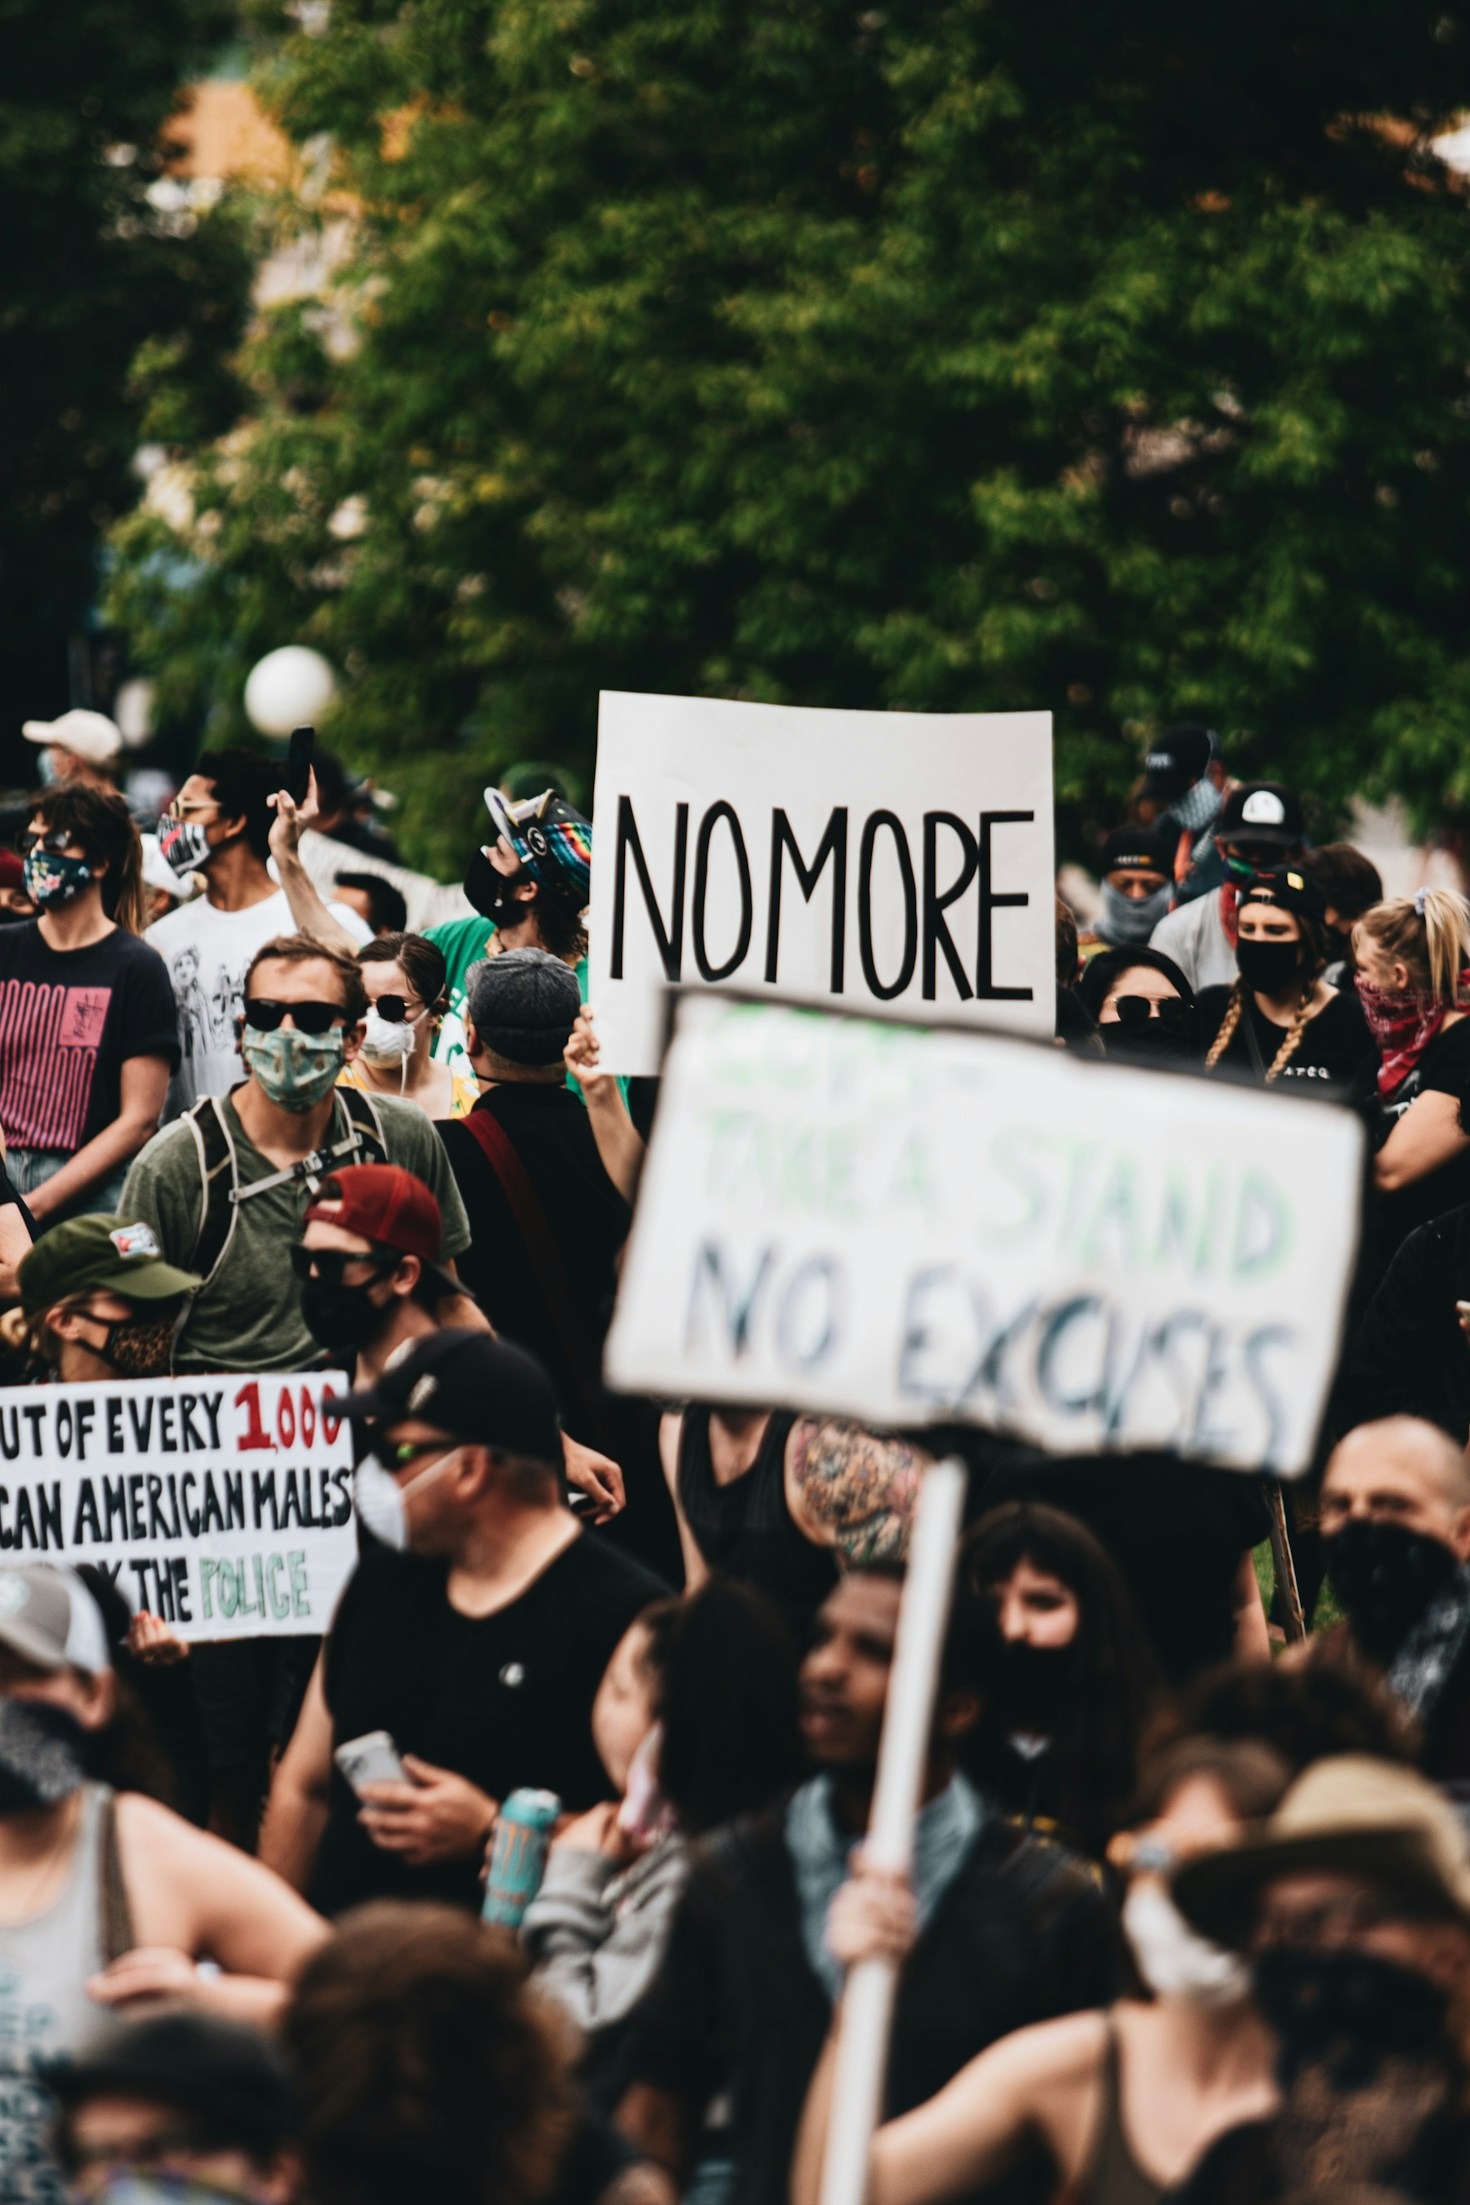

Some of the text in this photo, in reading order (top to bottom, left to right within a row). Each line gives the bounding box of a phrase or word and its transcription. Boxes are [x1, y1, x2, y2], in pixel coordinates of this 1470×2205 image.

[610, 795, 1035, 1001] NO MORE
[980, 1120, 1299, 1285] STAND
[683, 1230, 850, 1378] NO
[56, 1398, 95, 1460] OF
[106, 1390, 224, 1453] EVERY
[73, 1468, 245, 1545] AMERICAN
[252, 1466, 352, 1531] MALES
[129, 1557, 192, 1622] THE
[199, 1550, 310, 1620] POLICE
